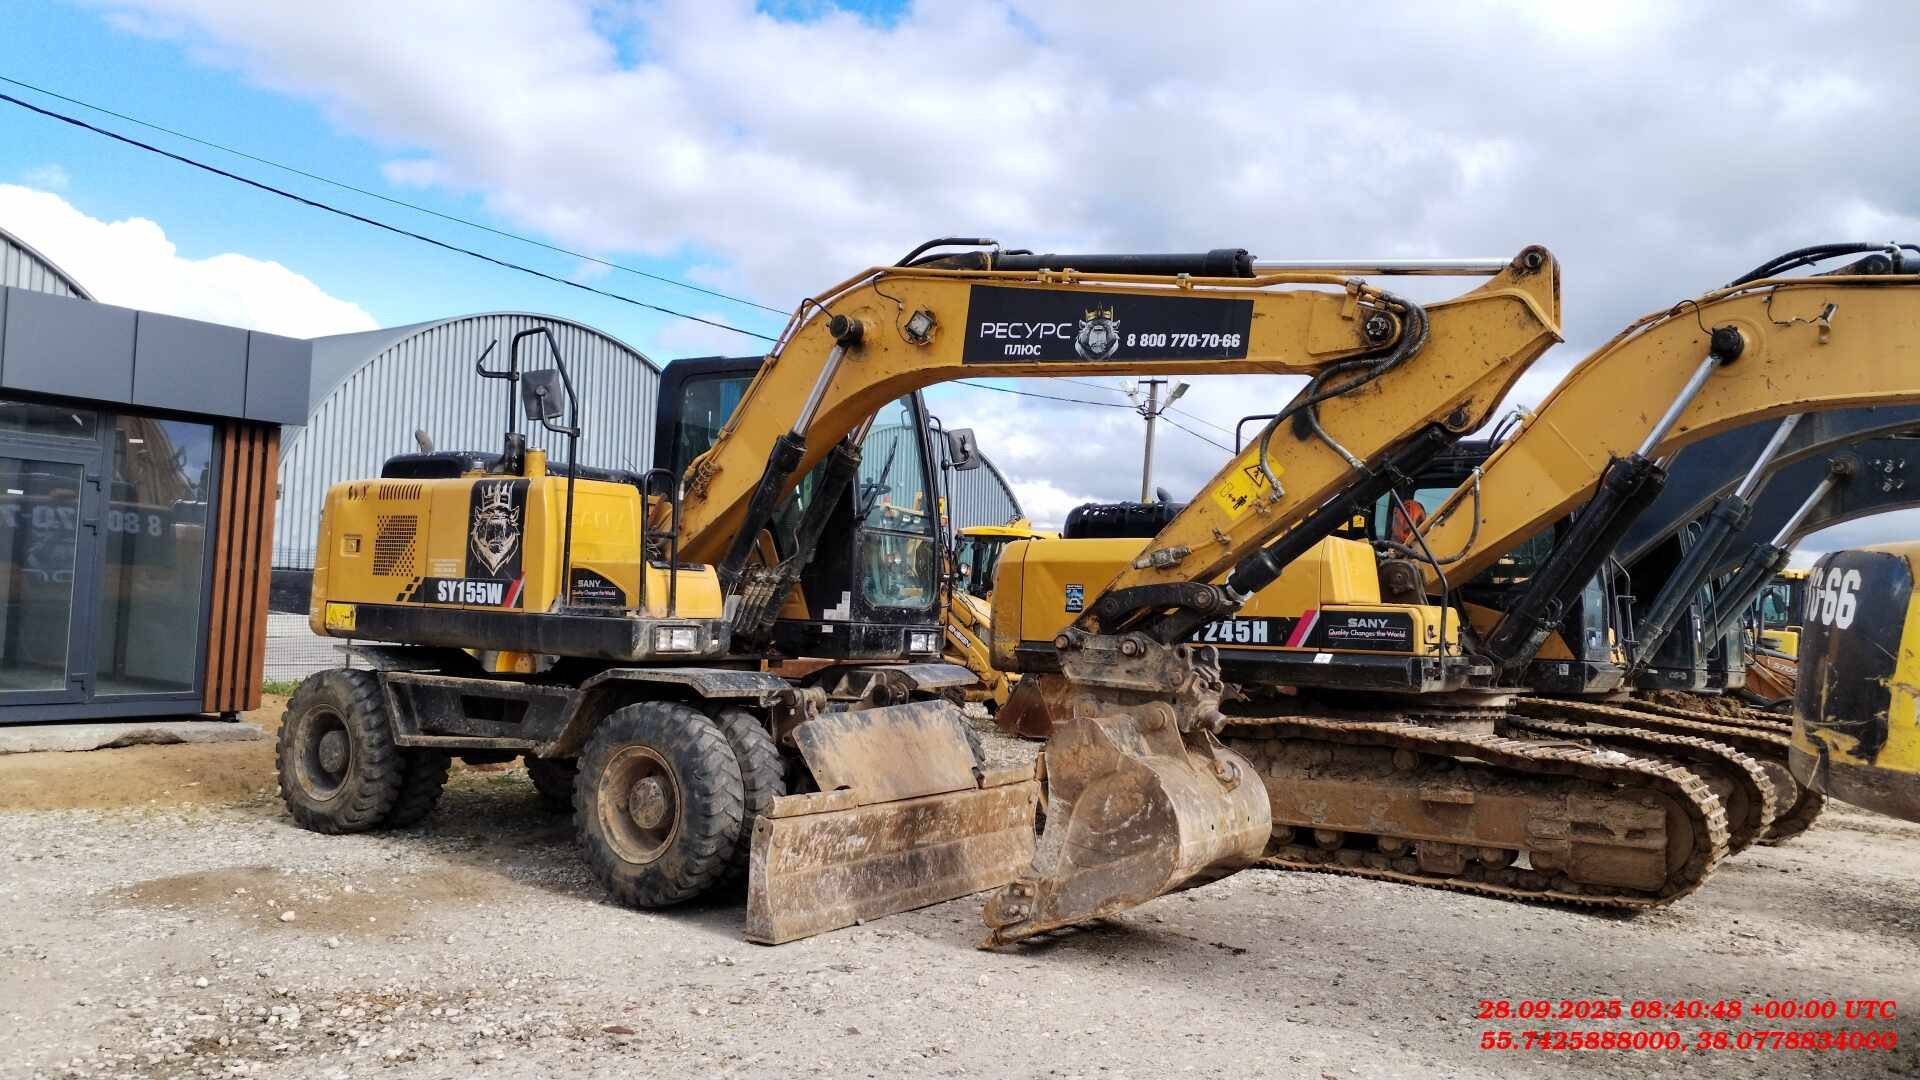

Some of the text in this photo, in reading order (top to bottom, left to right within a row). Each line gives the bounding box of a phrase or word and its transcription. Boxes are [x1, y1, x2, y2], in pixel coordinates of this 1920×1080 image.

[980, 322, 1072, 339] РЕСУРС
[1126, 333, 1241, 348] 8 800 770-70-66
[577, 579, 601, 588] SANY
[437, 579, 504, 605] SY155W
[1347, 617, 1388, 628] SANY
[1328, 628, 1350, 637] Quality
[1350, 629, 1375, 638] Changes
[1386, 630, 1406, 638] World
